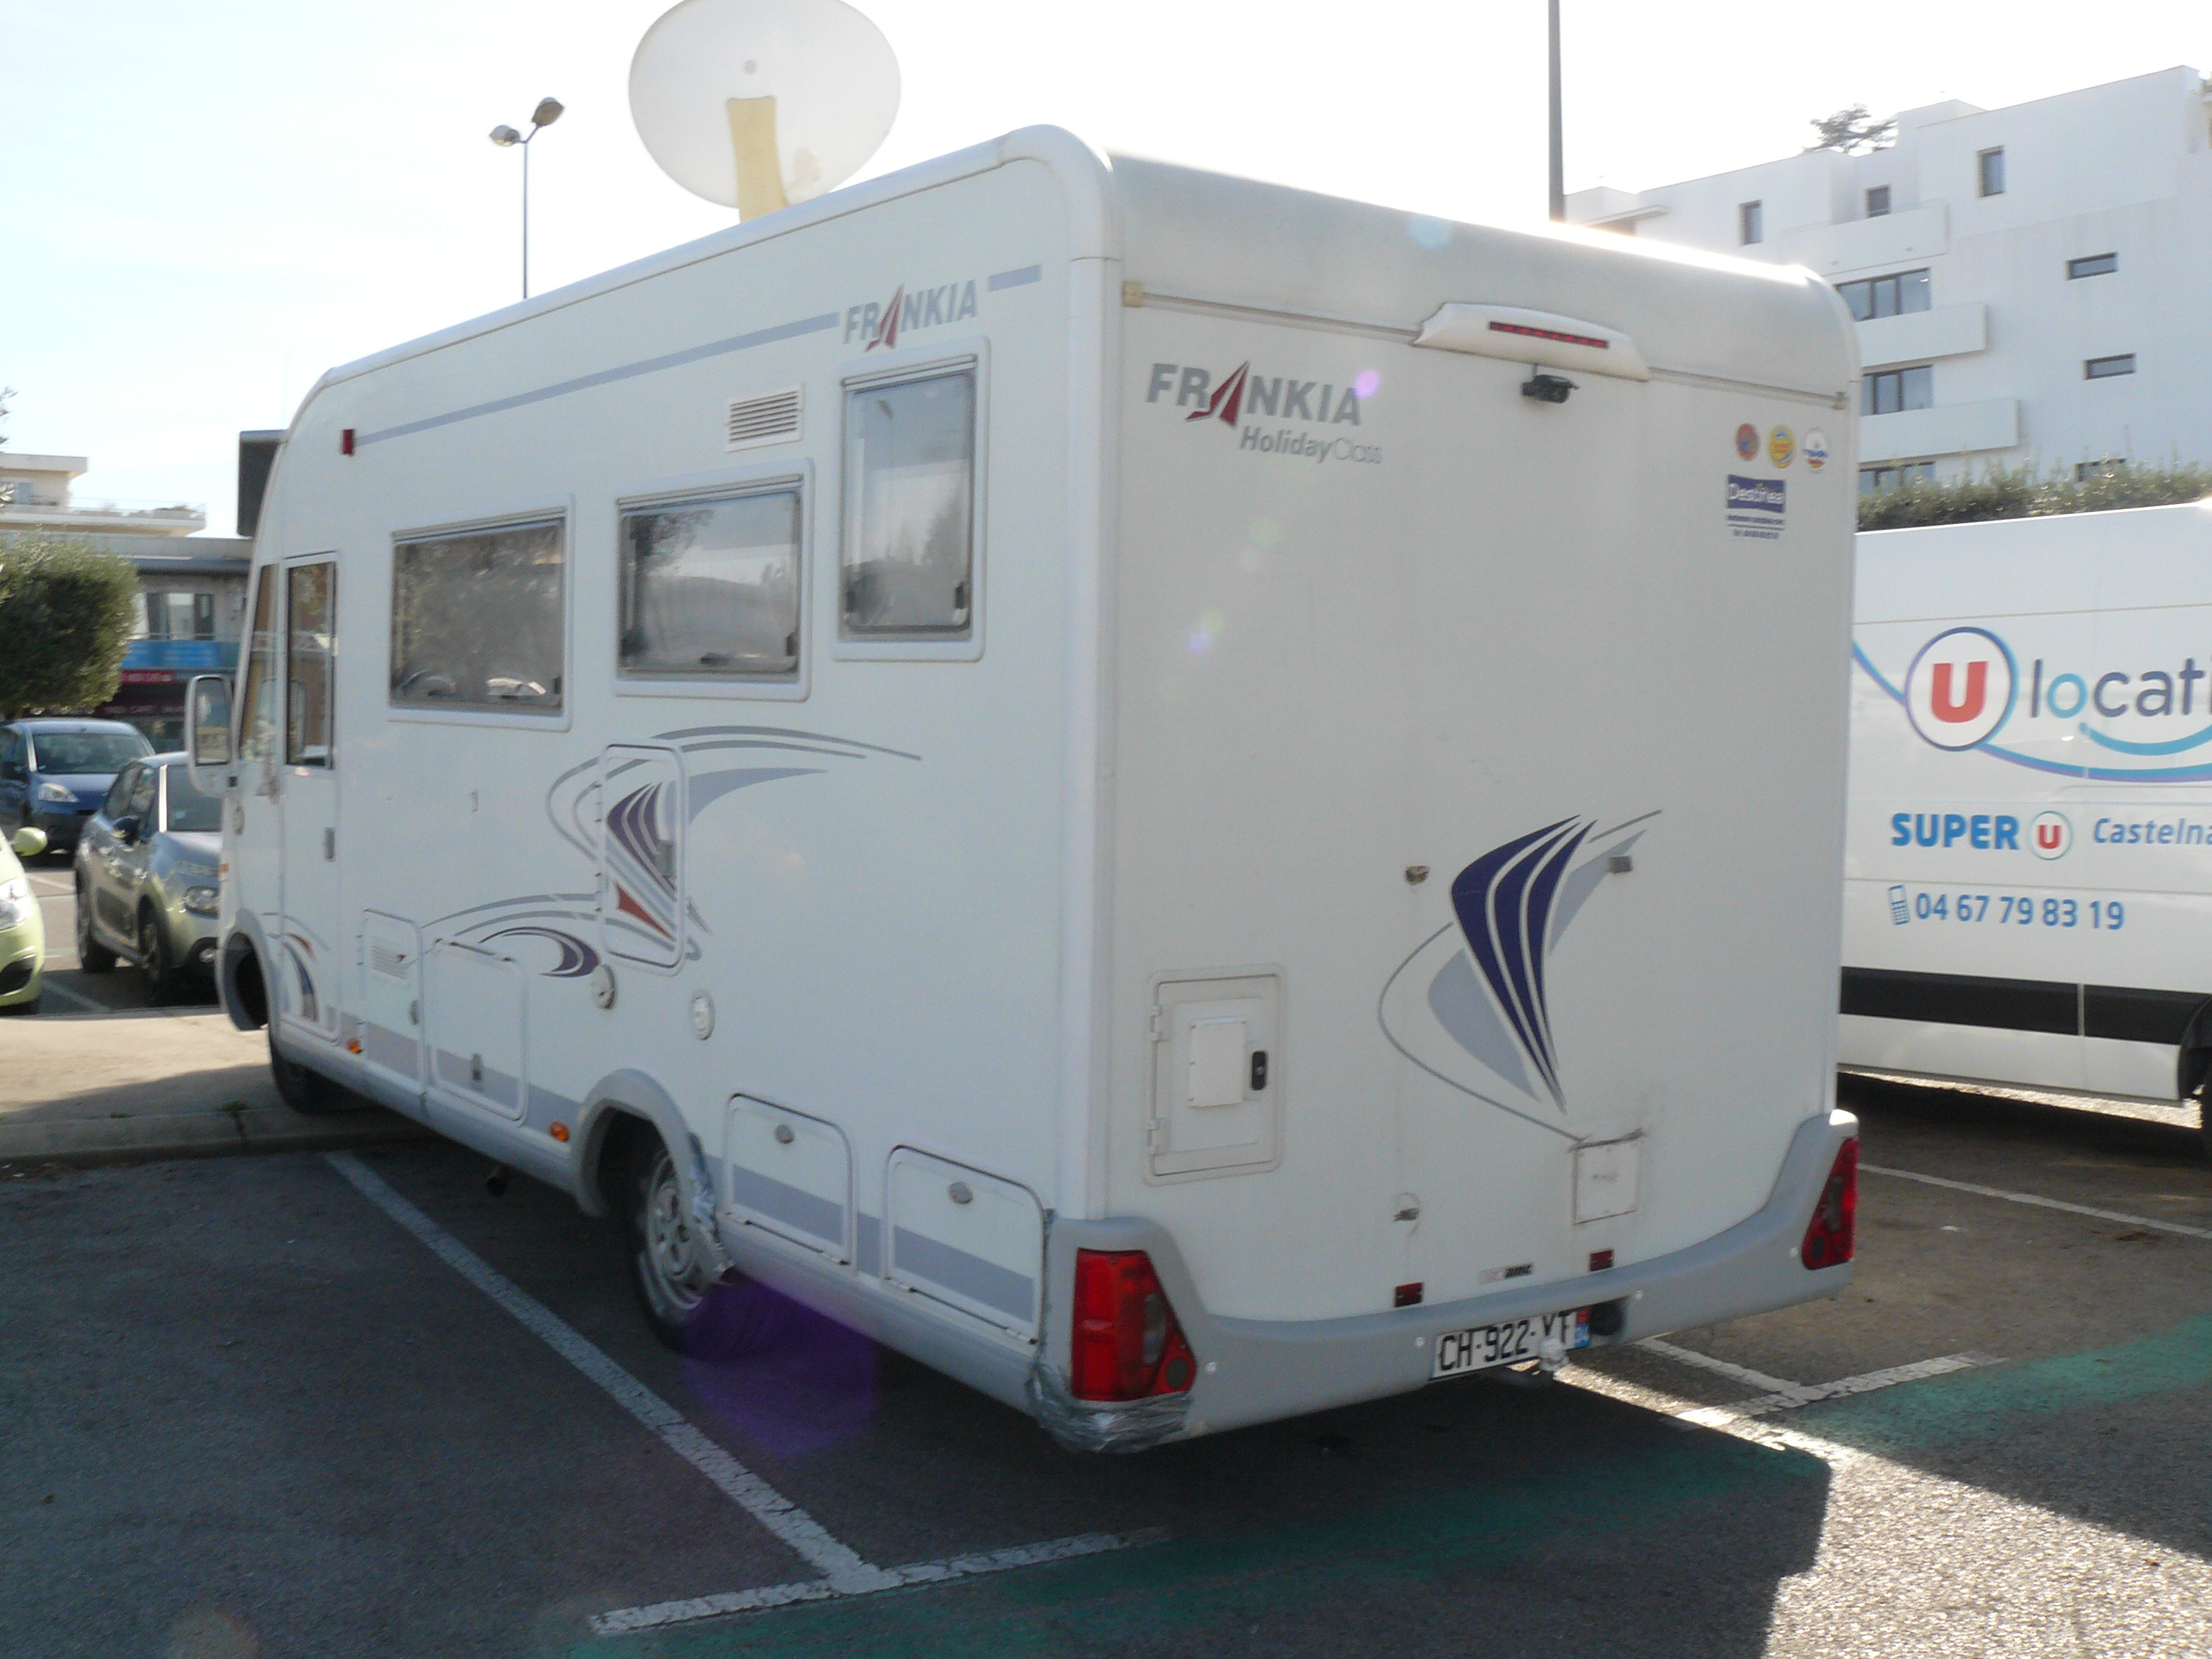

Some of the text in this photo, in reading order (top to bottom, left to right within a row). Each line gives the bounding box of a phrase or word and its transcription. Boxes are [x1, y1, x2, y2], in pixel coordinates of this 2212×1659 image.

[842, 279, 979, 352] FRANKIA
[1146, 360, 1362, 429] FRANKIA
[1930, 657, 2212, 724] U locat
[1891, 812, 2020, 851] SUPER
[2036, 824, 2062, 850] U
[1916, 891, 2126, 931] 04 67 79 83 19
